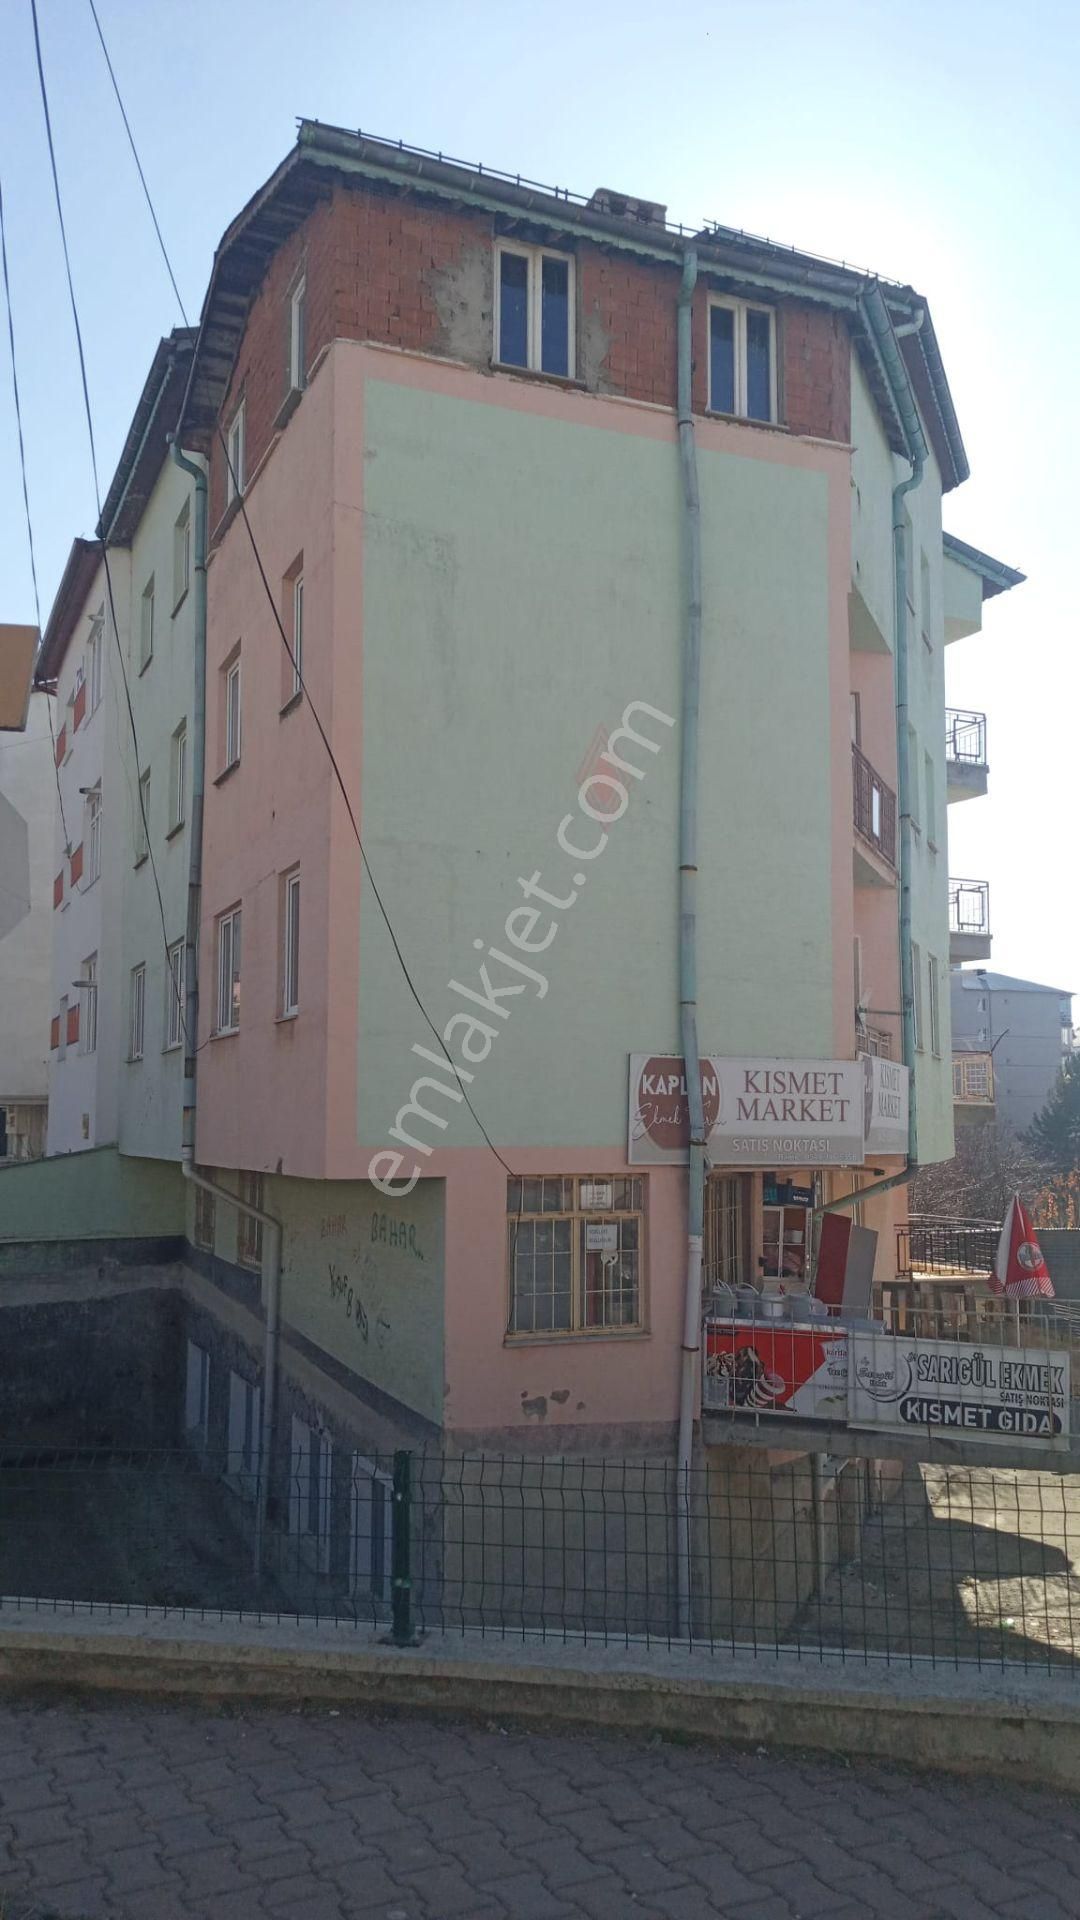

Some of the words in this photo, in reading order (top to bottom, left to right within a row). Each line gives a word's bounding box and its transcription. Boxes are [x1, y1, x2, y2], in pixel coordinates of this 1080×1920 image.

[642, 1074, 717, 1097] KAPLN
[744, 1070, 844, 1095] KISMET
[737, 1098, 850, 1121] MARKET
[773, 1139, 830, 1153] NOKTASI
[917, 1352, 996, 1388] SARIGÜL
[1000, 1361, 1064, 1395] EKMEK
[1026, 1394, 1064, 1408] NOKTASI
[905, 1400, 992, 1429] KISMET
[998, 1411, 1052, 1435] GIDA
